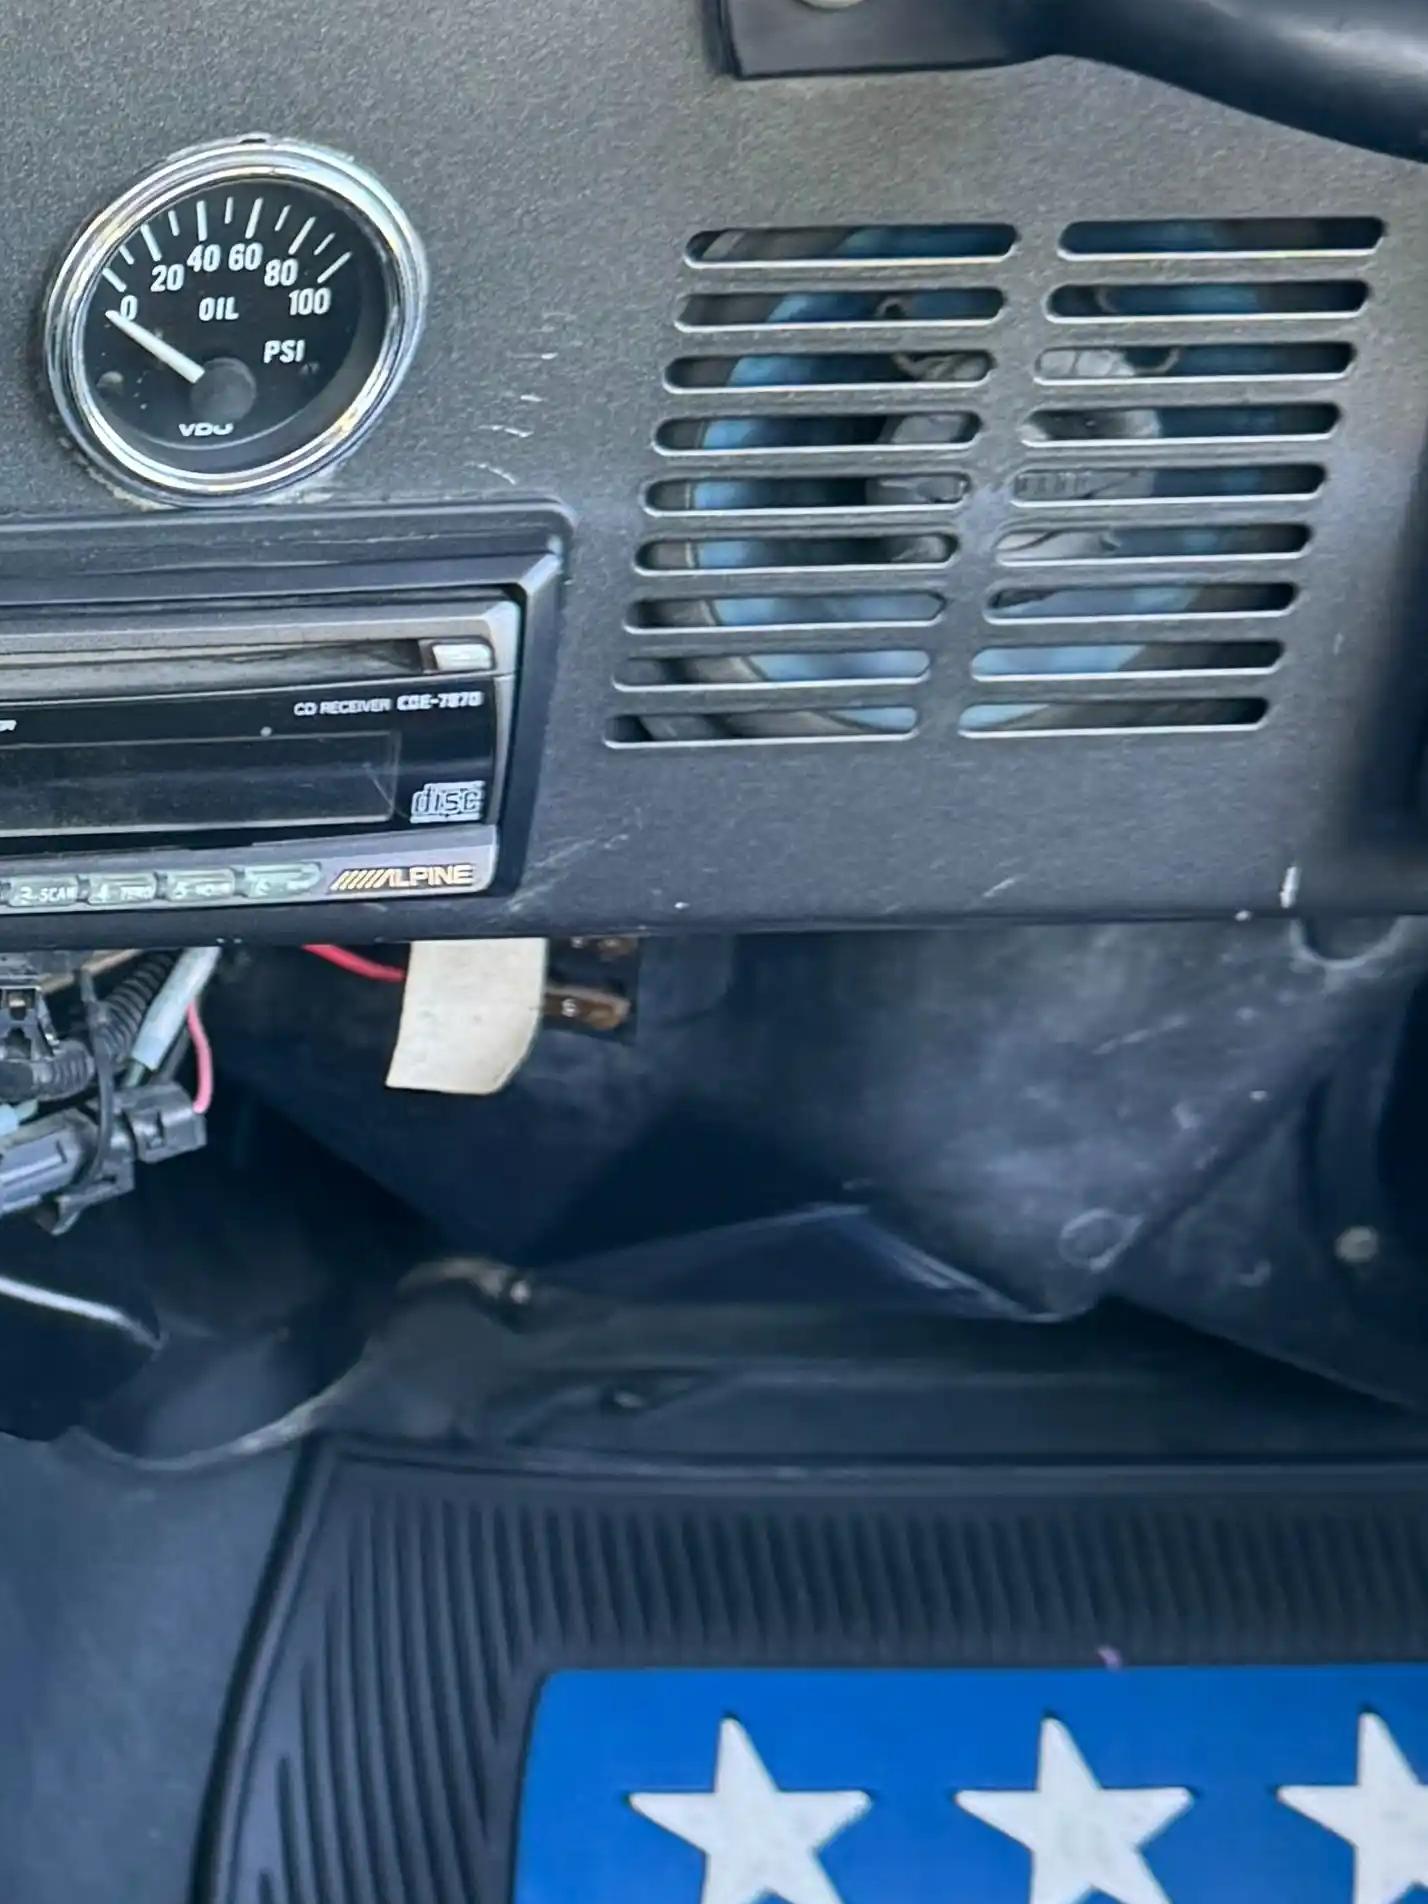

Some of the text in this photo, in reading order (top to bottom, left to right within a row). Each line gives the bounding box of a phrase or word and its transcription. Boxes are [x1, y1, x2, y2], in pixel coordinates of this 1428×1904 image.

[186, 244, 221, 272] 40
[228, 243, 264, 271] 60
[150, 264, 185, 292] 20
[264, 259, 299, 287] 80
[119, 295, 138, 322] 0
[198, 297, 239, 321] OIL
[288, 288, 332, 315] 100
[263, 340, 306, 363] PSI
[294, 702, 317, 716] CD
[319, 698, 392, 714] RECEIVER
[366, 864, 475, 889] ALPINE
